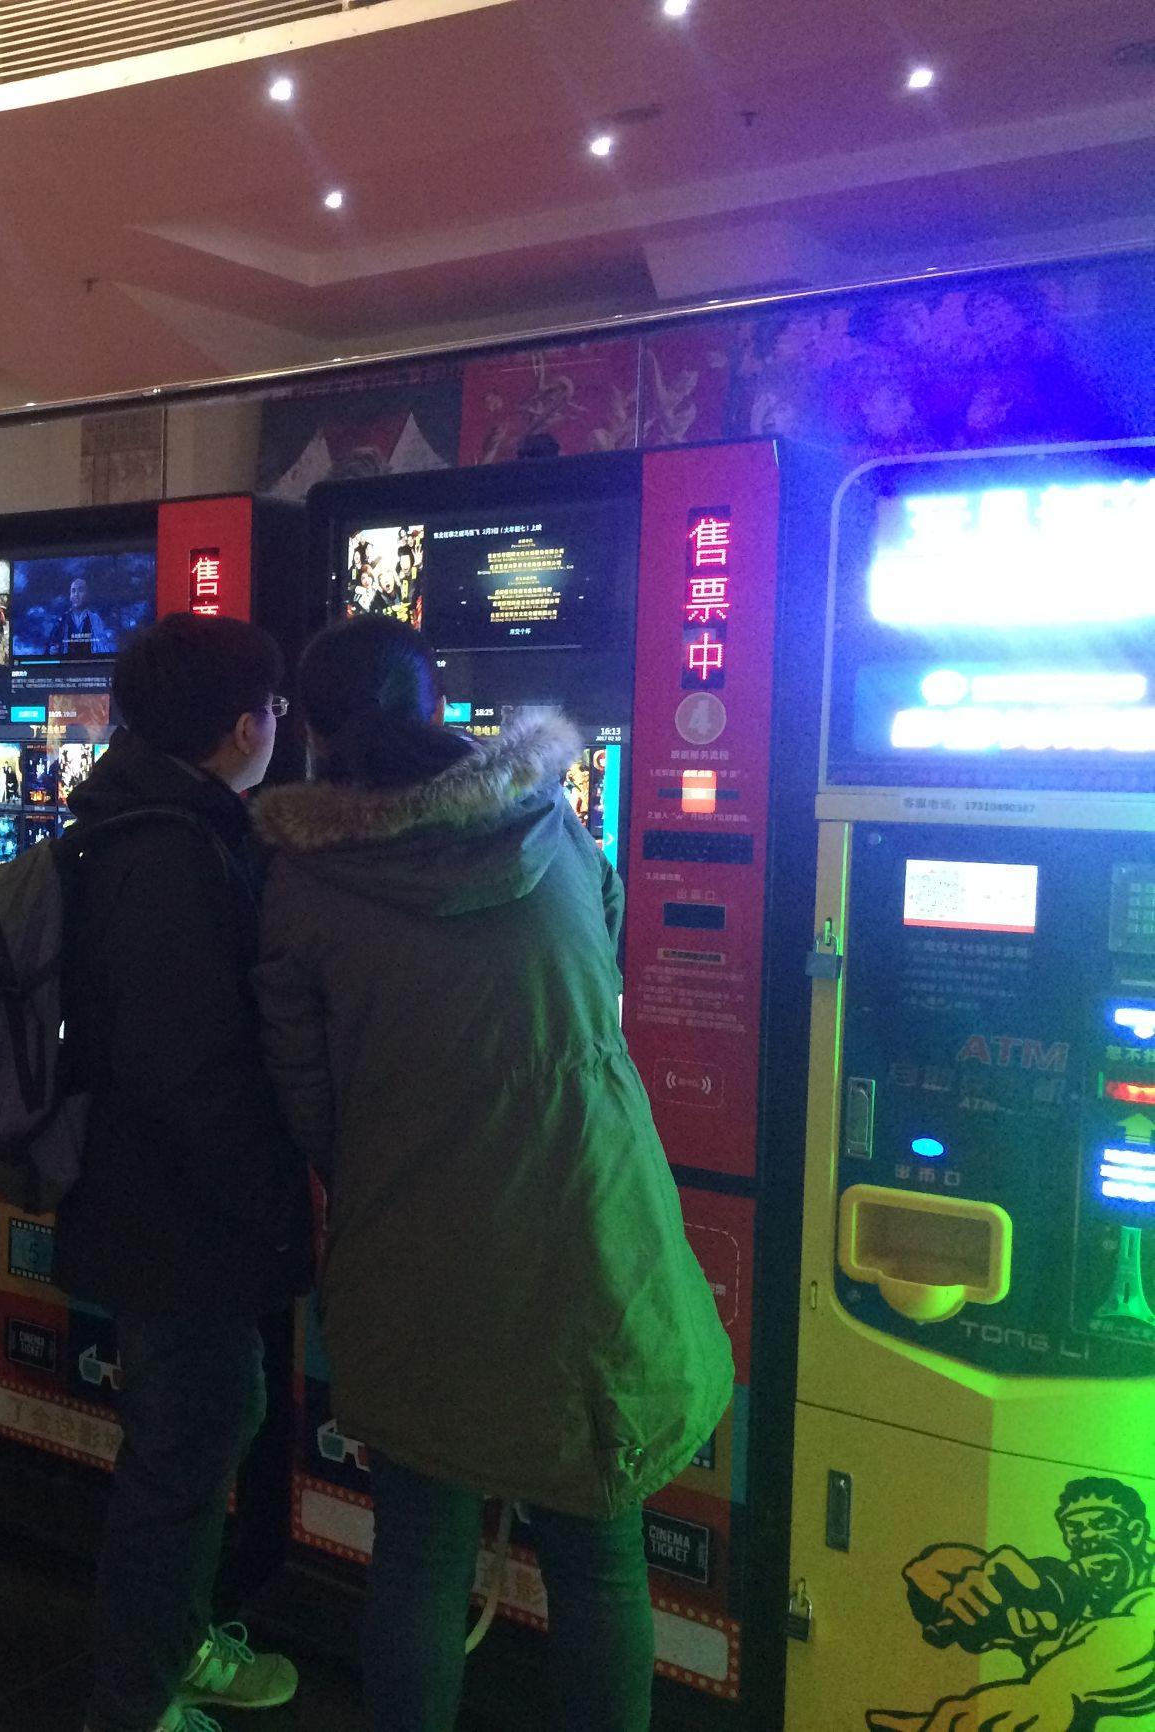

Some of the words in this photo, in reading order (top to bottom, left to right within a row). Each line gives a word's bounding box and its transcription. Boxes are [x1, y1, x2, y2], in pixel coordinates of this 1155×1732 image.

[686, 517, 729, 681] 售票中
[600, 727, 621, 735] 16:13
[688, 699, 712, 734] 4
[957, 1034, 1069, 1073] ATM
[959, 1320, 1050, 1352] TONG
[1059, 1340, 1090, 1360] LI
[648, 1525, 691, 1551] CINEMA
[650, 1538, 689, 1562] TICKET
